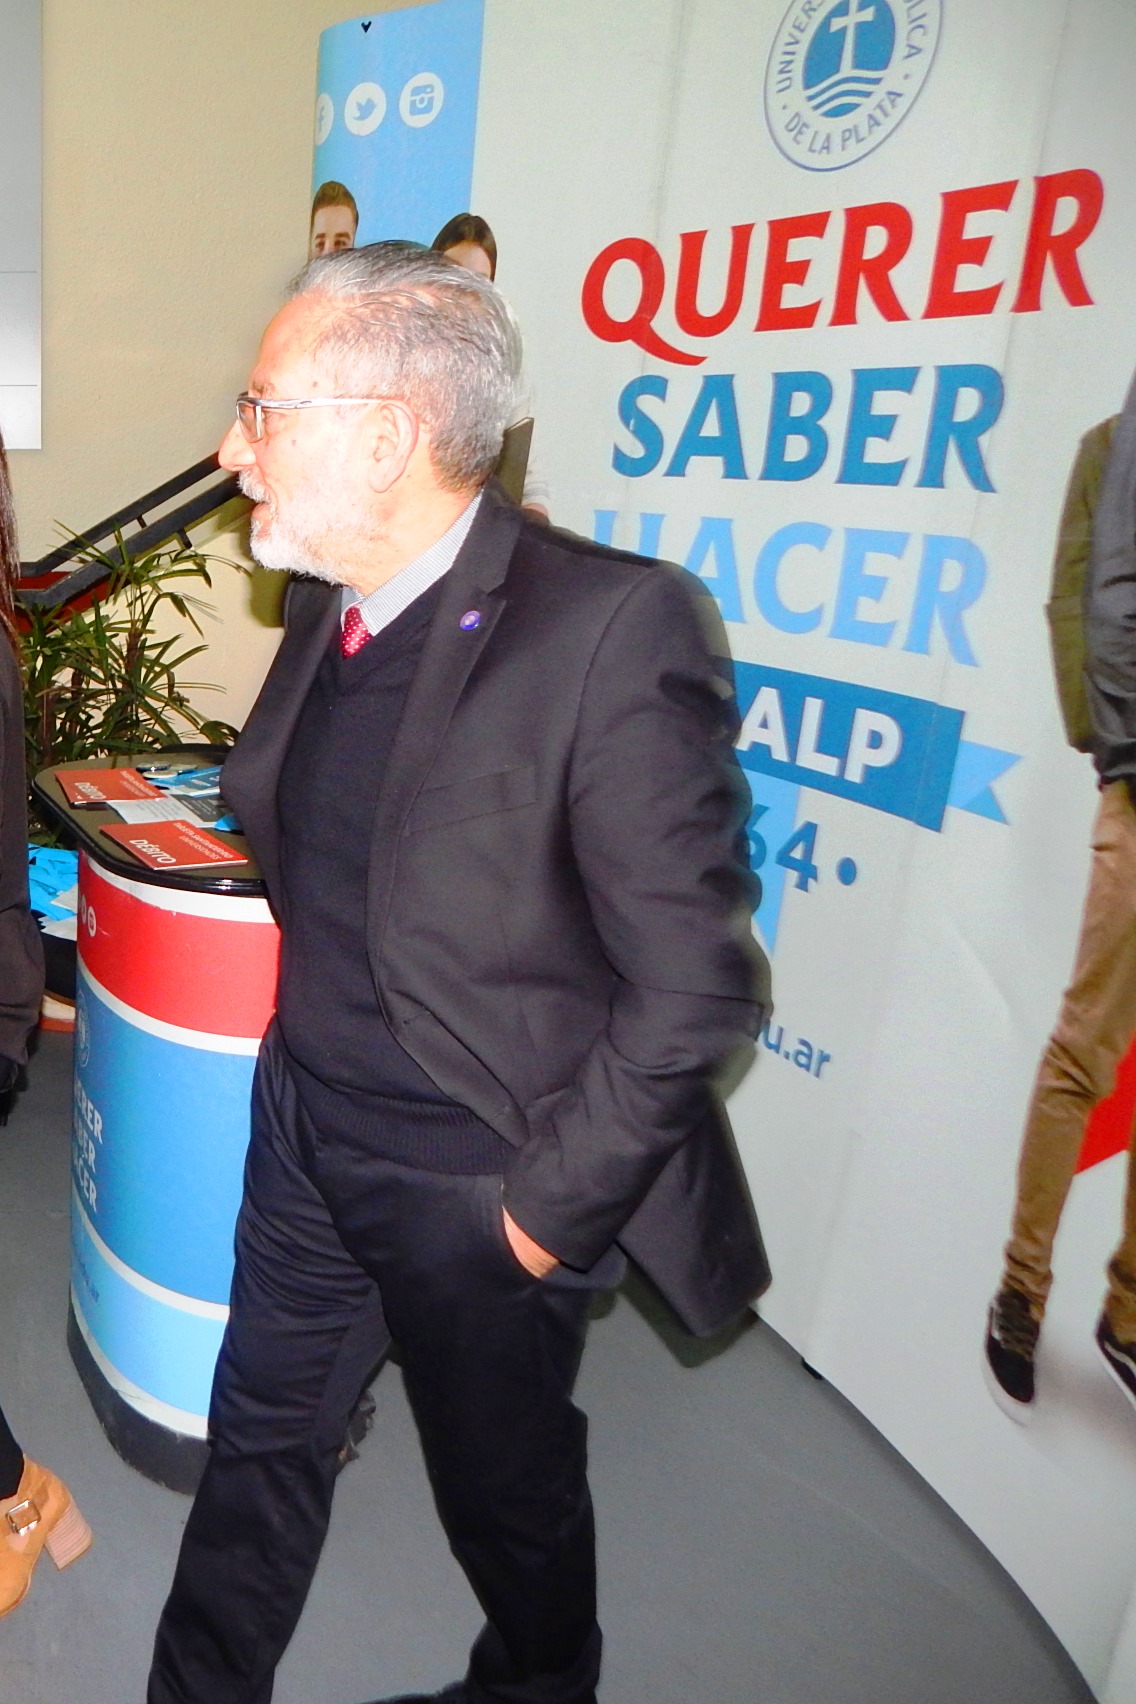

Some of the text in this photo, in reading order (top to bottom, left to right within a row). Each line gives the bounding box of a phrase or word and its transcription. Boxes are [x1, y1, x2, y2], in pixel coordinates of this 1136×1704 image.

[775, 0, 820, 94] UNIVER
[785, 90, 904, 155] DE LA PLATA
[581, 168, 1105, 366] QUERER
[612, 363, 1006, 494] SABER
[128, 839, 177, 864] DÉBITO
